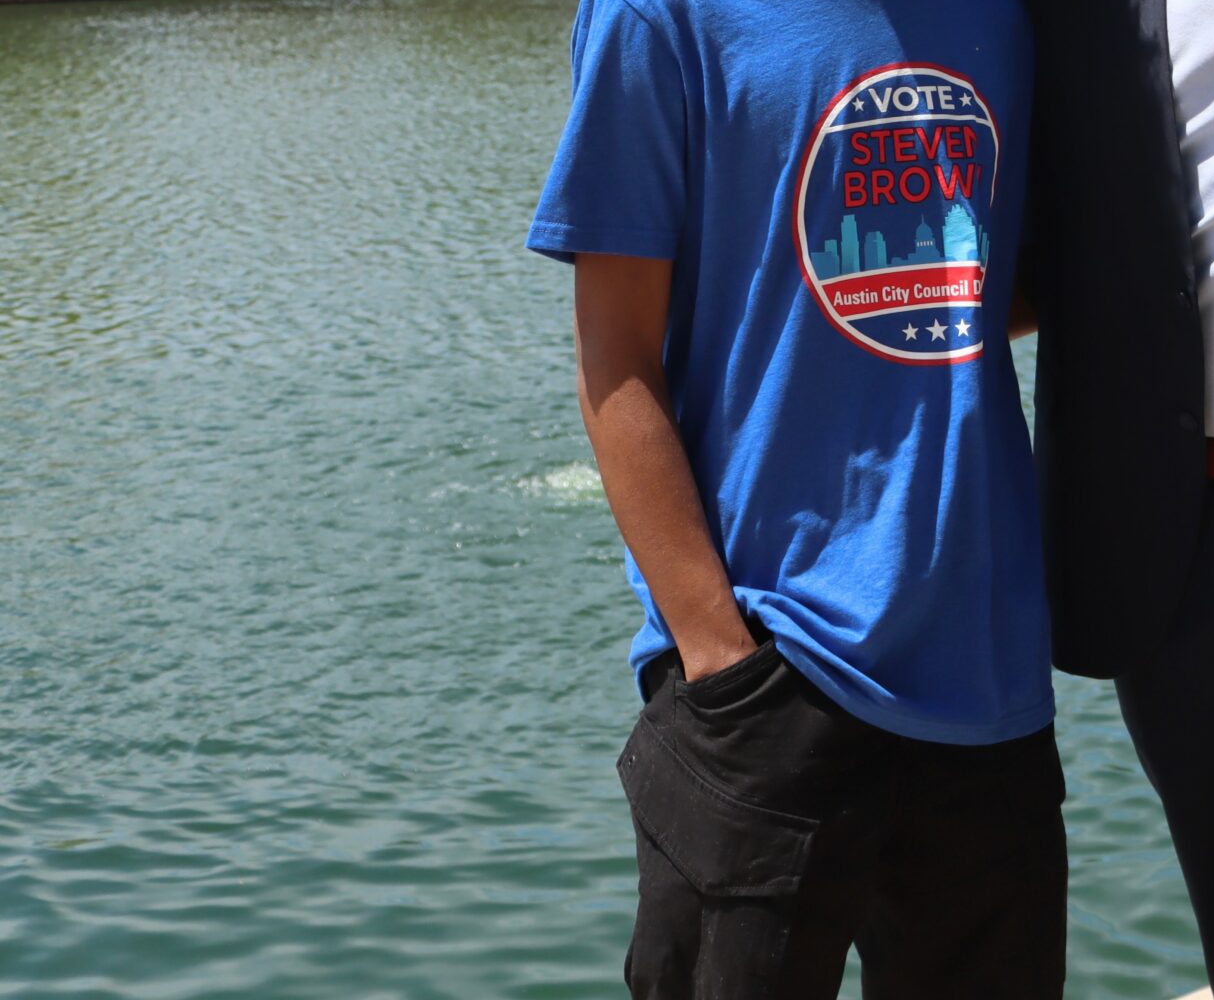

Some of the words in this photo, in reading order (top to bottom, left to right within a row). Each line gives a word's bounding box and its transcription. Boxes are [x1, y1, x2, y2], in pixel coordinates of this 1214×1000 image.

[868, 86, 955, 112] VOTE
[844, 163, 981, 208] BROW
[833, 289, 878, 306] Austin
[882, 285, 910, 303] City
[913, 280, 968, 298] Council
